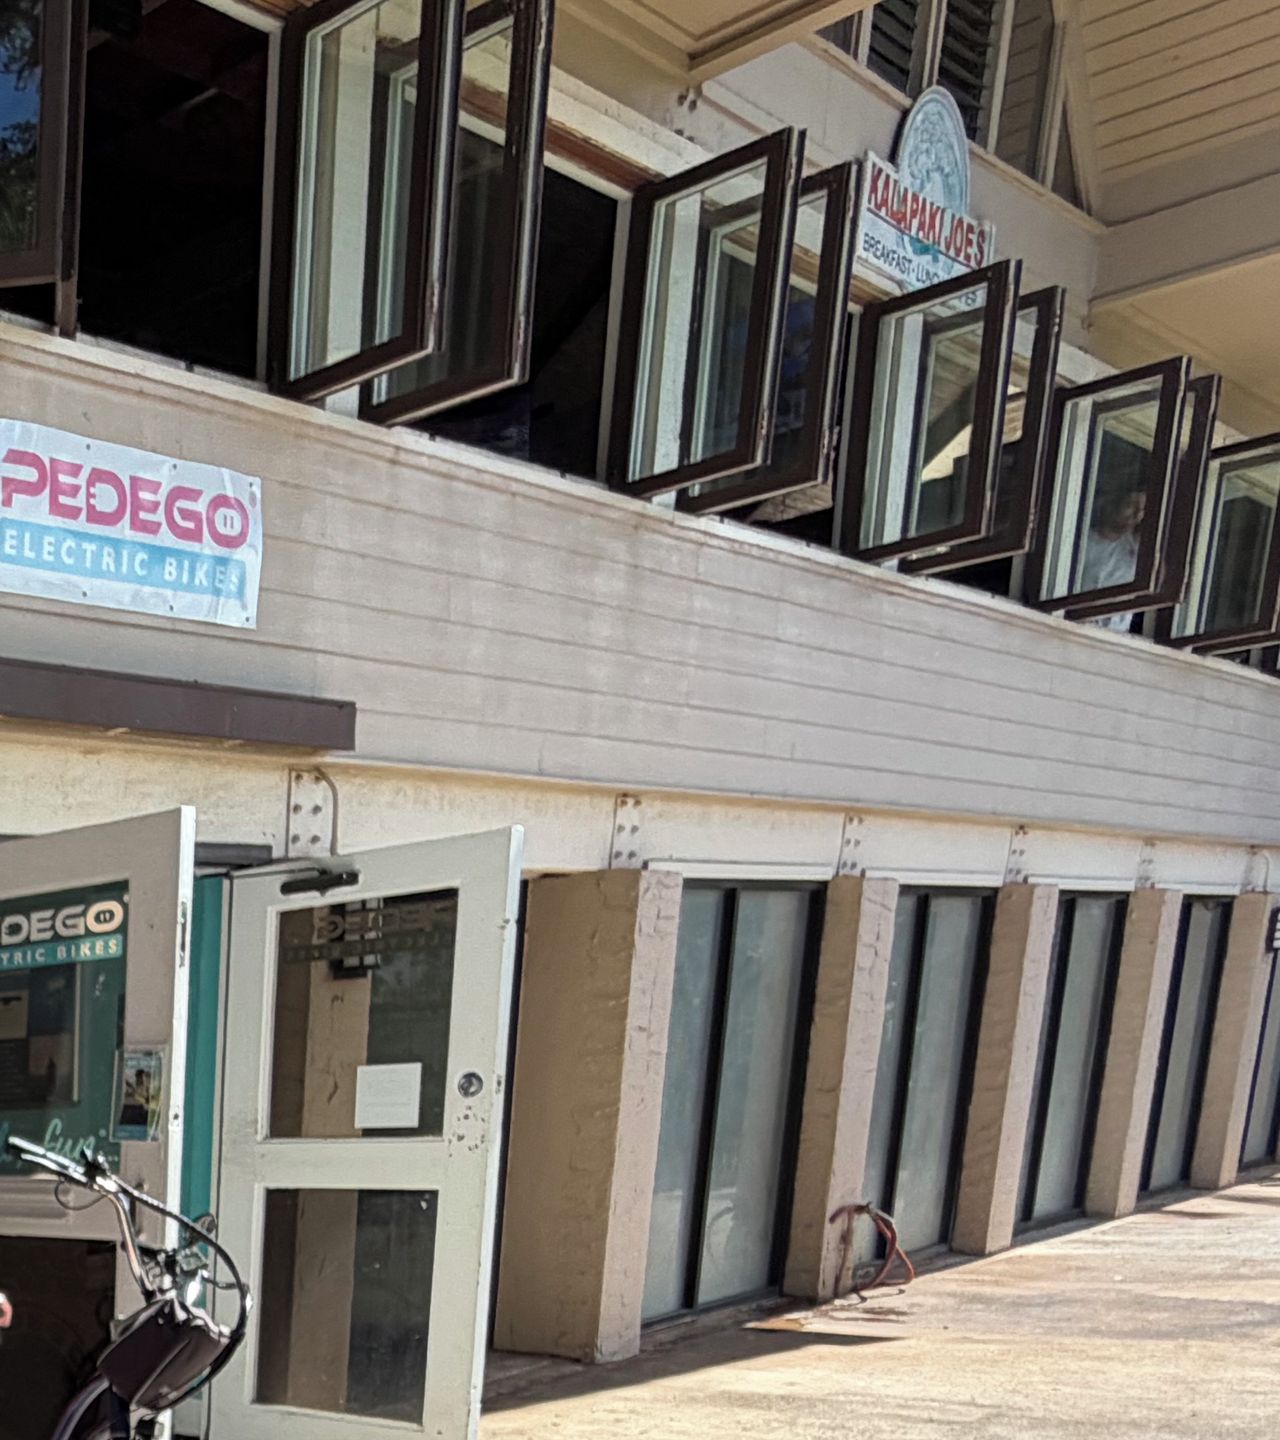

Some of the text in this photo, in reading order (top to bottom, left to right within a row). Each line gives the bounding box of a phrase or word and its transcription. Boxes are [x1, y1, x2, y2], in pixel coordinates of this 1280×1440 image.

[868, 161, 946, 248] KALAPAKI
[862, 232, 912, 276] BREAKFAST
[1, 447, 250, 549] PEDEGO
[3, 528, 241, 592] ELECTRIC BIKES
[56, 938, 118, 960] BIKES
